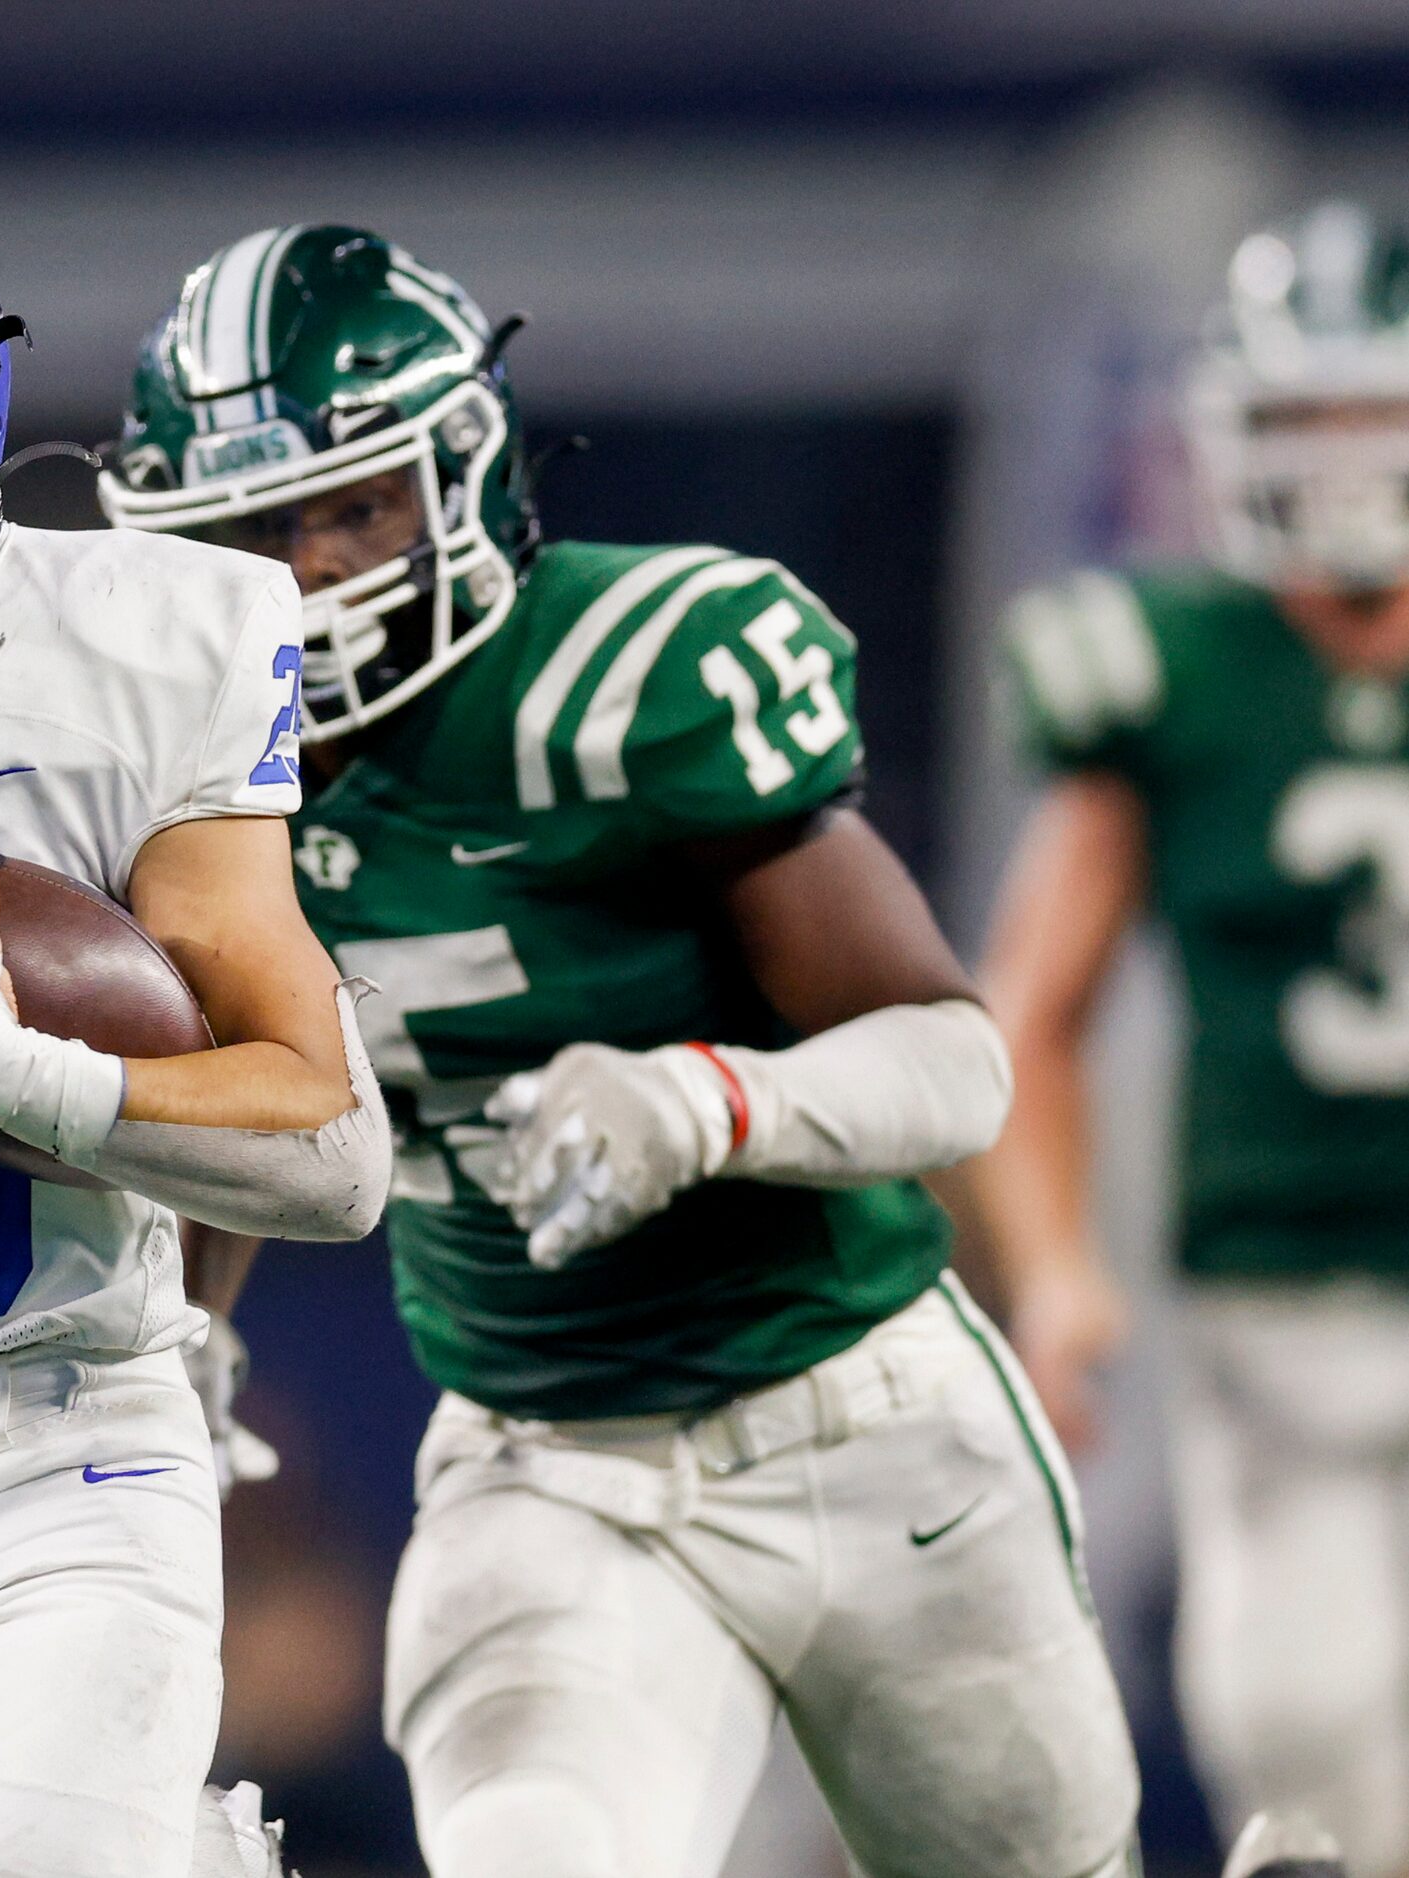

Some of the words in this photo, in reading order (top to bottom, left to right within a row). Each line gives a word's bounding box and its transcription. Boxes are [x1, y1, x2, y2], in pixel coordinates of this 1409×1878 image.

[196, 426, 289, 478] LIONS
[249, 644, 301, 785] 2
[699, 600, 848, 796] 15
